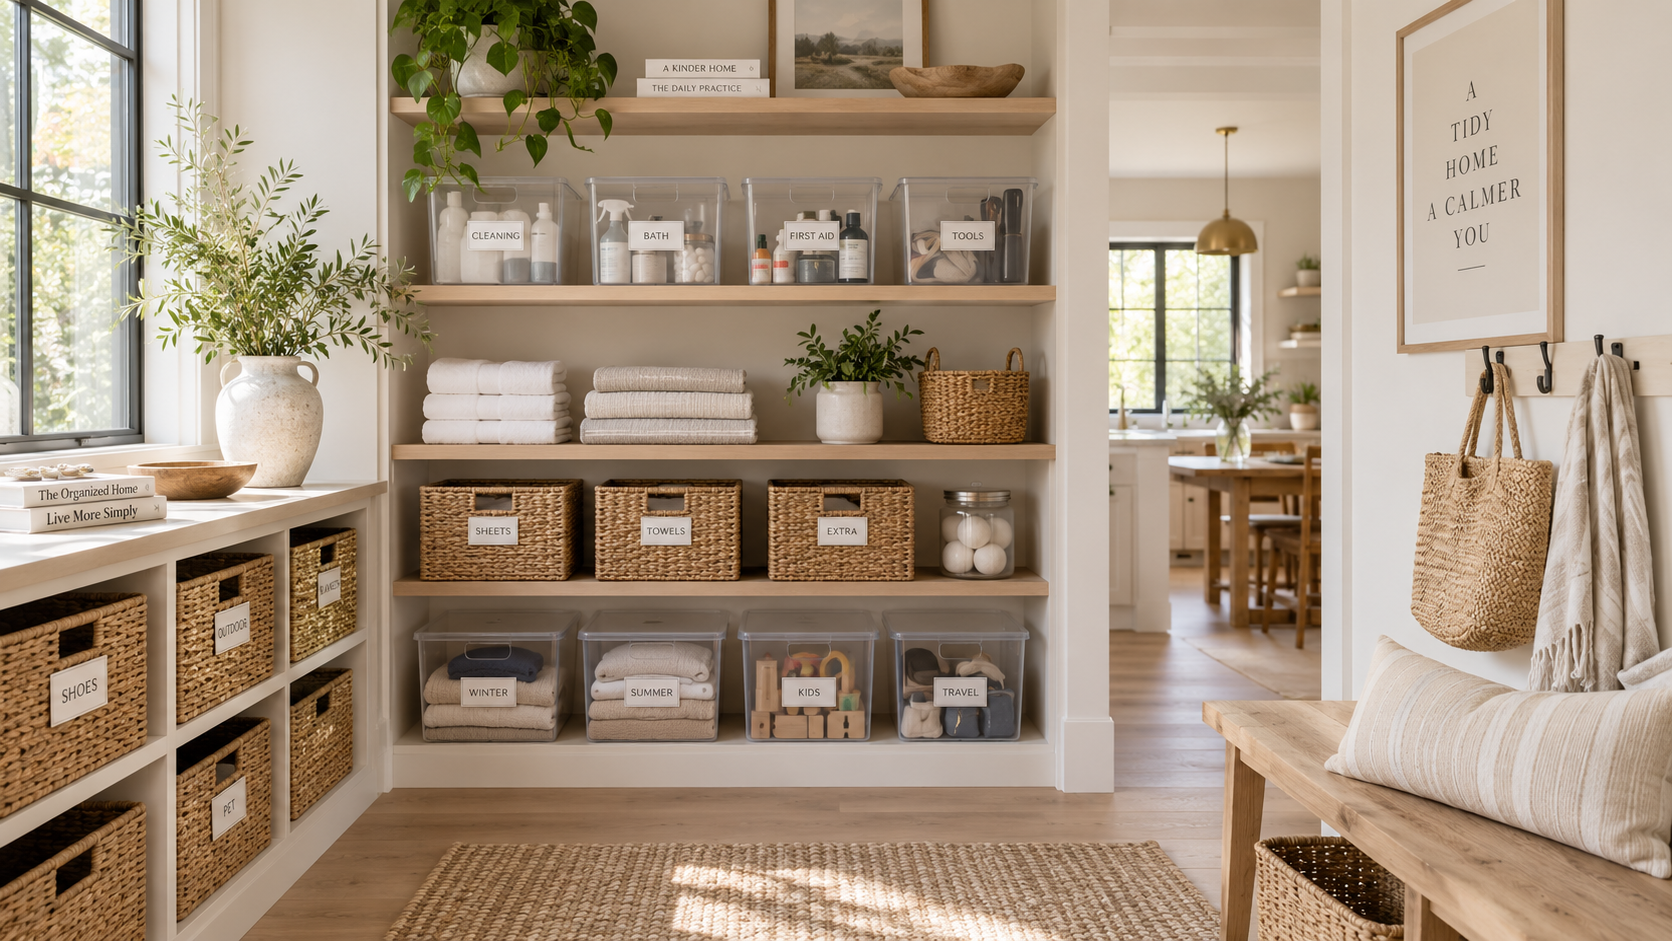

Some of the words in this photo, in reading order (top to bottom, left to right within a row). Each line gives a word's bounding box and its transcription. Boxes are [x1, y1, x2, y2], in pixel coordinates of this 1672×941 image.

[1465, 81, 1477, 101] A
[1451, 109, 1492, 142] TIDY
[1446, 145, 1498, 179] HOME
[1427, 203, 1437, 221] A
[1445, 178, 1521, 216] CALMER
[472, 231, 520, 239] CLEANING
[644, 231, 669, 239] BATH
[790, 232, 815, 240] FIRST
[818, 231, 834, 239] AID
[952, 232, 984, 240] TOOLS
[1454, 223, 1489, 248] YOU
[38, 489, 58, 501] The
[60, 485, 109, 501] Organized
[111, 484, 138, 495] Home
[47, 512, 70, 526] Live
[73, 509, 101, 522] More
[103, 504, 138, 519] Simply
[476, 527, 511, 535] SHEETS
[647, 527, 685, 535] TOWELS
[828, 527, 857, 535] EXTRA
[62, 678, 97, 703] SHOES
[469, 688, 508, 696] WINTER
[631, 688, 672, 696] SUMMER
[799, 688, 820, 696] KIDS
[943, 688, 979, 696] TRAVEL
[224, 799, 235, 817] PET
